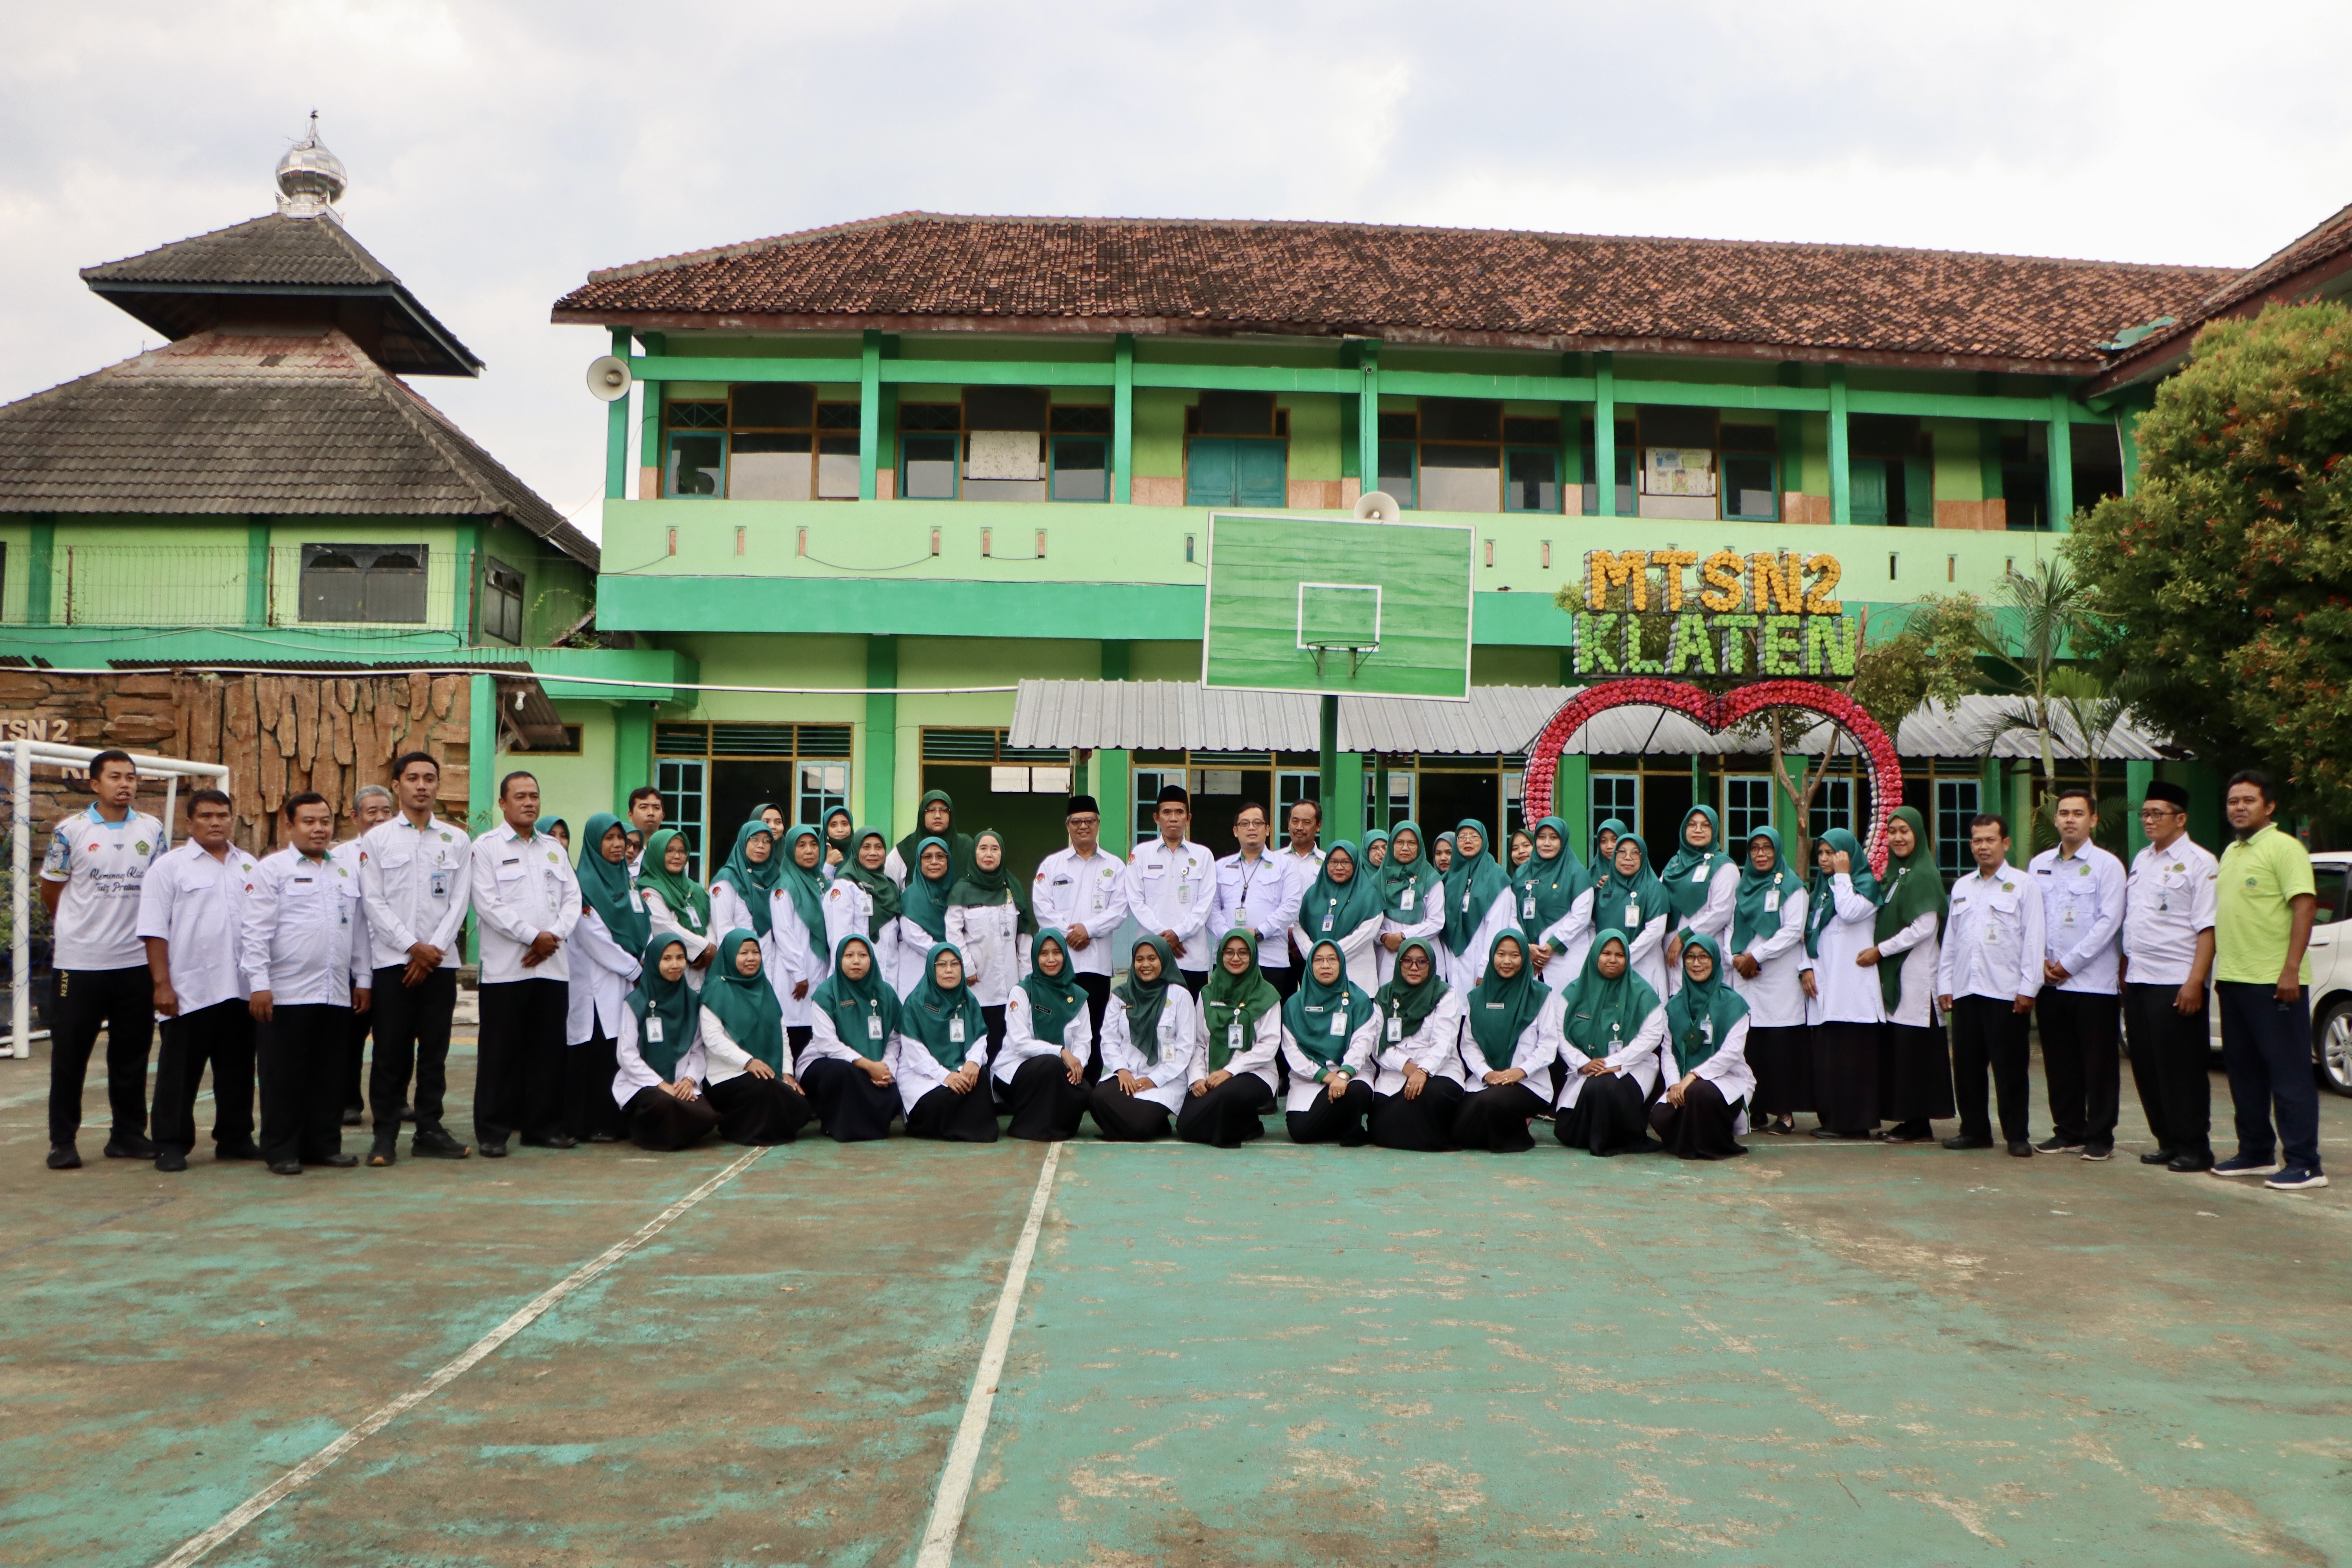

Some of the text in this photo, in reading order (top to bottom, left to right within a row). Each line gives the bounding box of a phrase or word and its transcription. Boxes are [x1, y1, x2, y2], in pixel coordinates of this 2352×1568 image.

[1573, 612, 1855, 676] KLATEN
[52, 719, 69, 742] 2
[112, 882, 141, 892] Pratam
